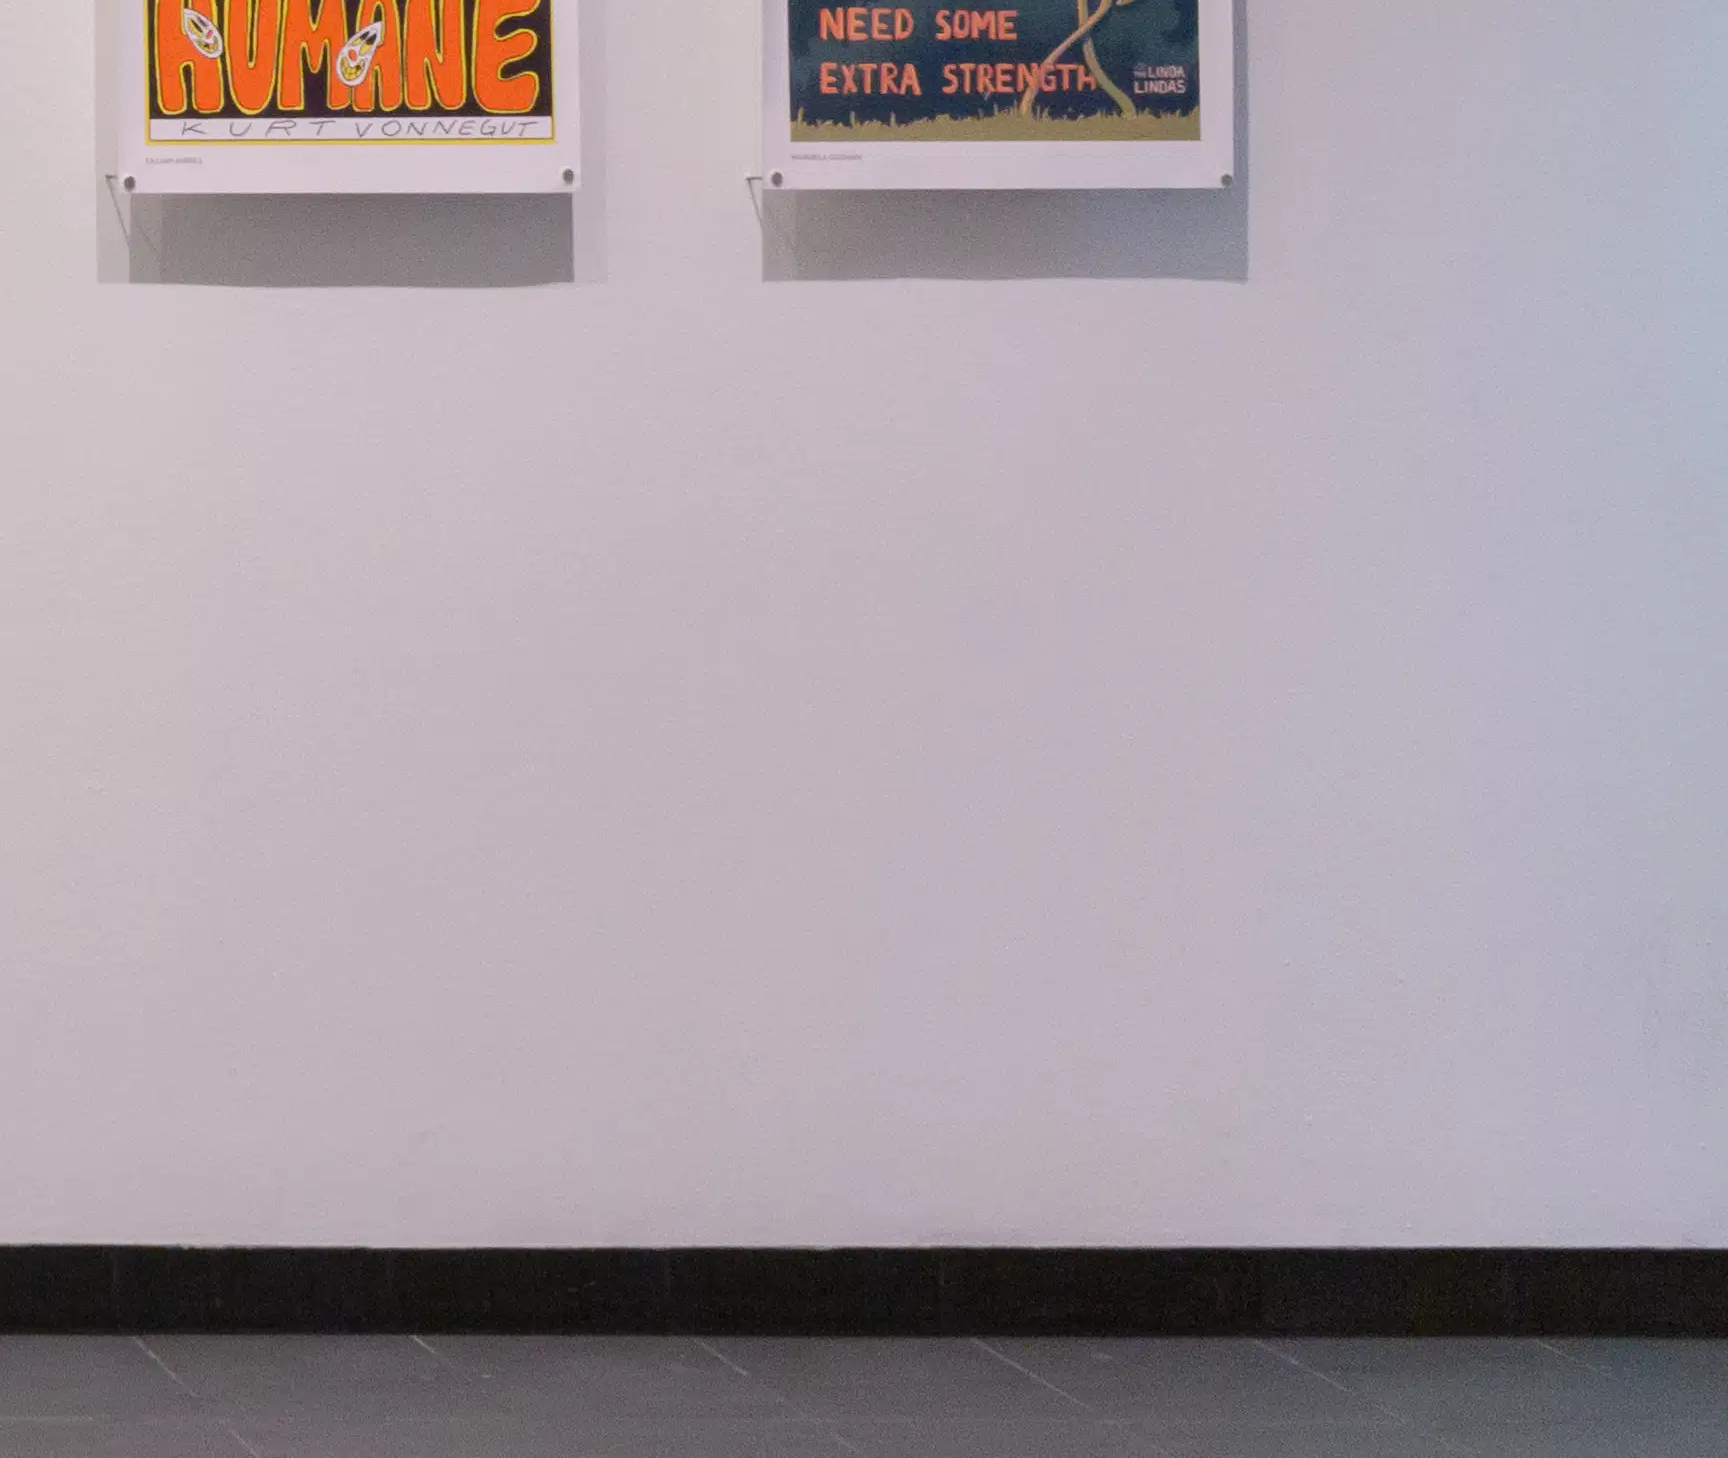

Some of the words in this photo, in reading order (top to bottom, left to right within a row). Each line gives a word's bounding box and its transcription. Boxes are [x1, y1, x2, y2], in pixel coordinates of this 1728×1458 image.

[818, 6, 914, 41] NEED
[935, 10, 1018, 41] SOME
[818, 62, 922, 96] EXTRA
[941, 62, 1097, 96] STRENGTH
[1133, 81, 1186, 94] LINDAS
[180, 119, 336, 138] KURT
[353, 118, 540, 139] VONNEGUT
